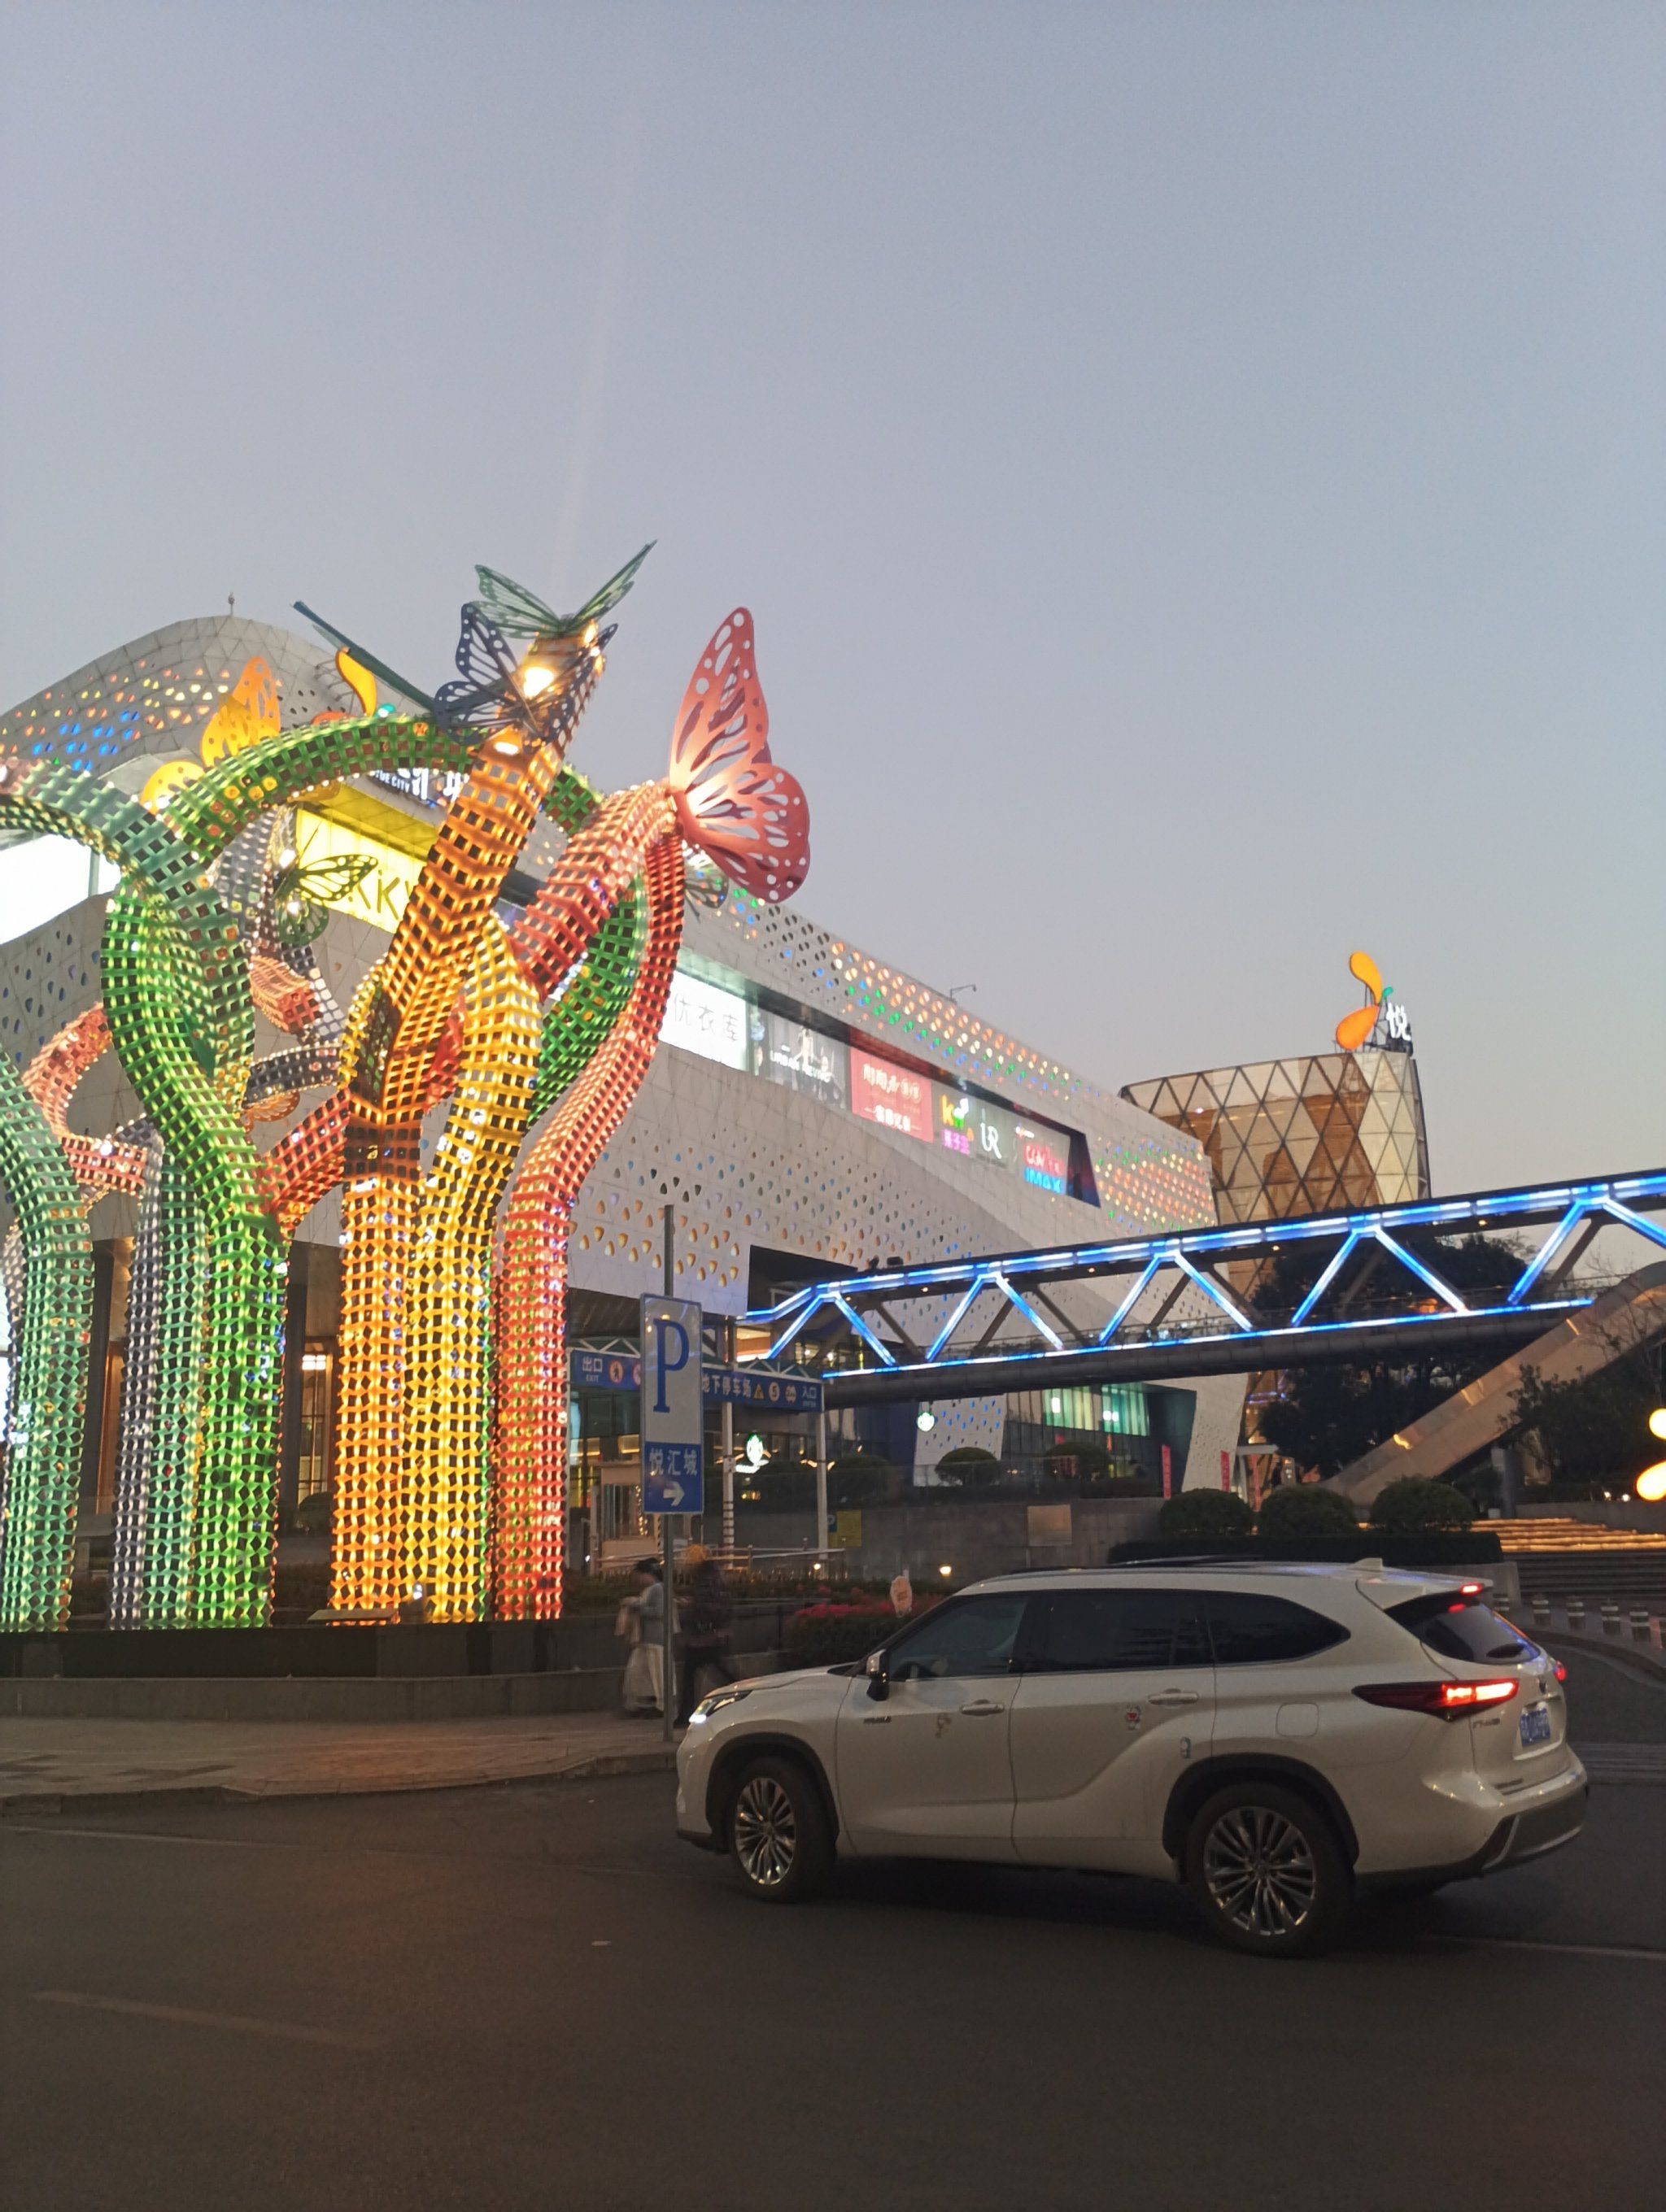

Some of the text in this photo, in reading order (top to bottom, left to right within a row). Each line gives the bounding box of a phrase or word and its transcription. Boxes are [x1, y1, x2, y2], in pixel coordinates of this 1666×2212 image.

[1024, 1165, 1066, 1195] IMAX
[582, 1356, 603, 1374] 出口
[652, 1317, 690, 1413] P
[802, 1386, 817, 1400] 入口
[649, 1448, 698, 1477] 悦汇城
